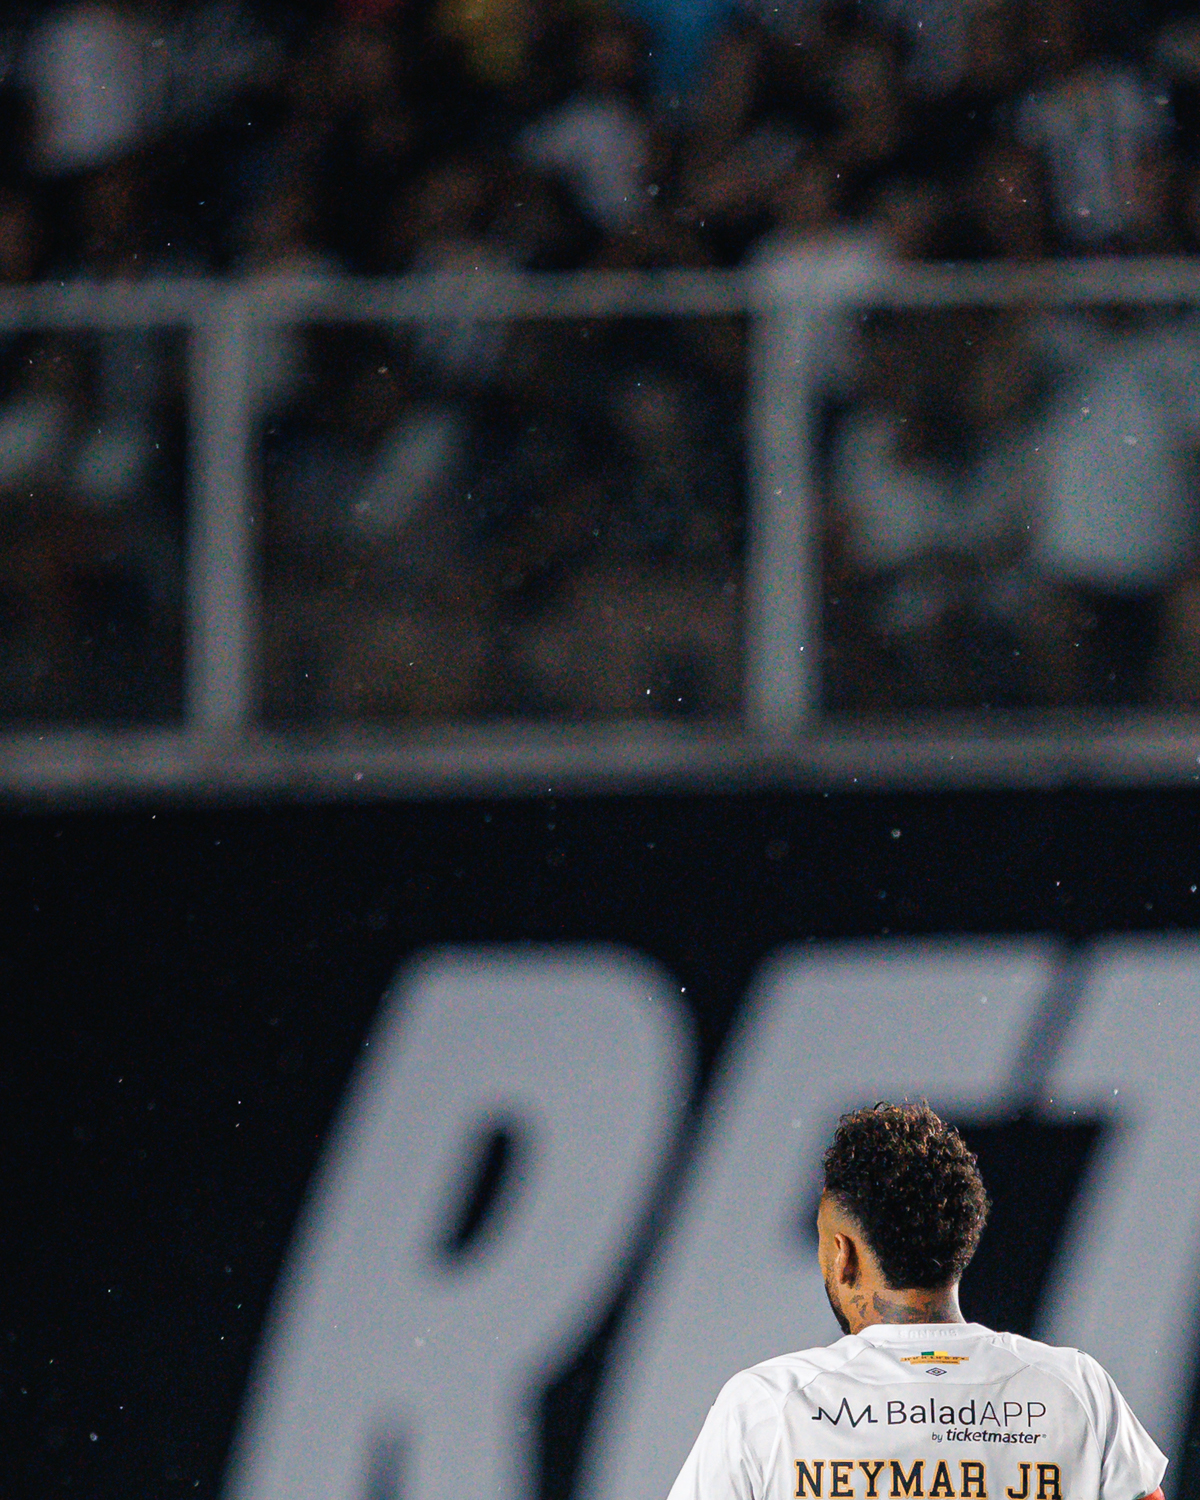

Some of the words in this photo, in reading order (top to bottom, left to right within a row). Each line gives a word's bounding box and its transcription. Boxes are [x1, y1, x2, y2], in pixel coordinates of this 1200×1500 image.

[887, 1397, 1047, 1428] BaladAPP
[931, 1431, 943, 1444] by
[946, 1428, 1041, 1444] ticketmaster
[794, 1459, 989, 1500] NEYMAR
